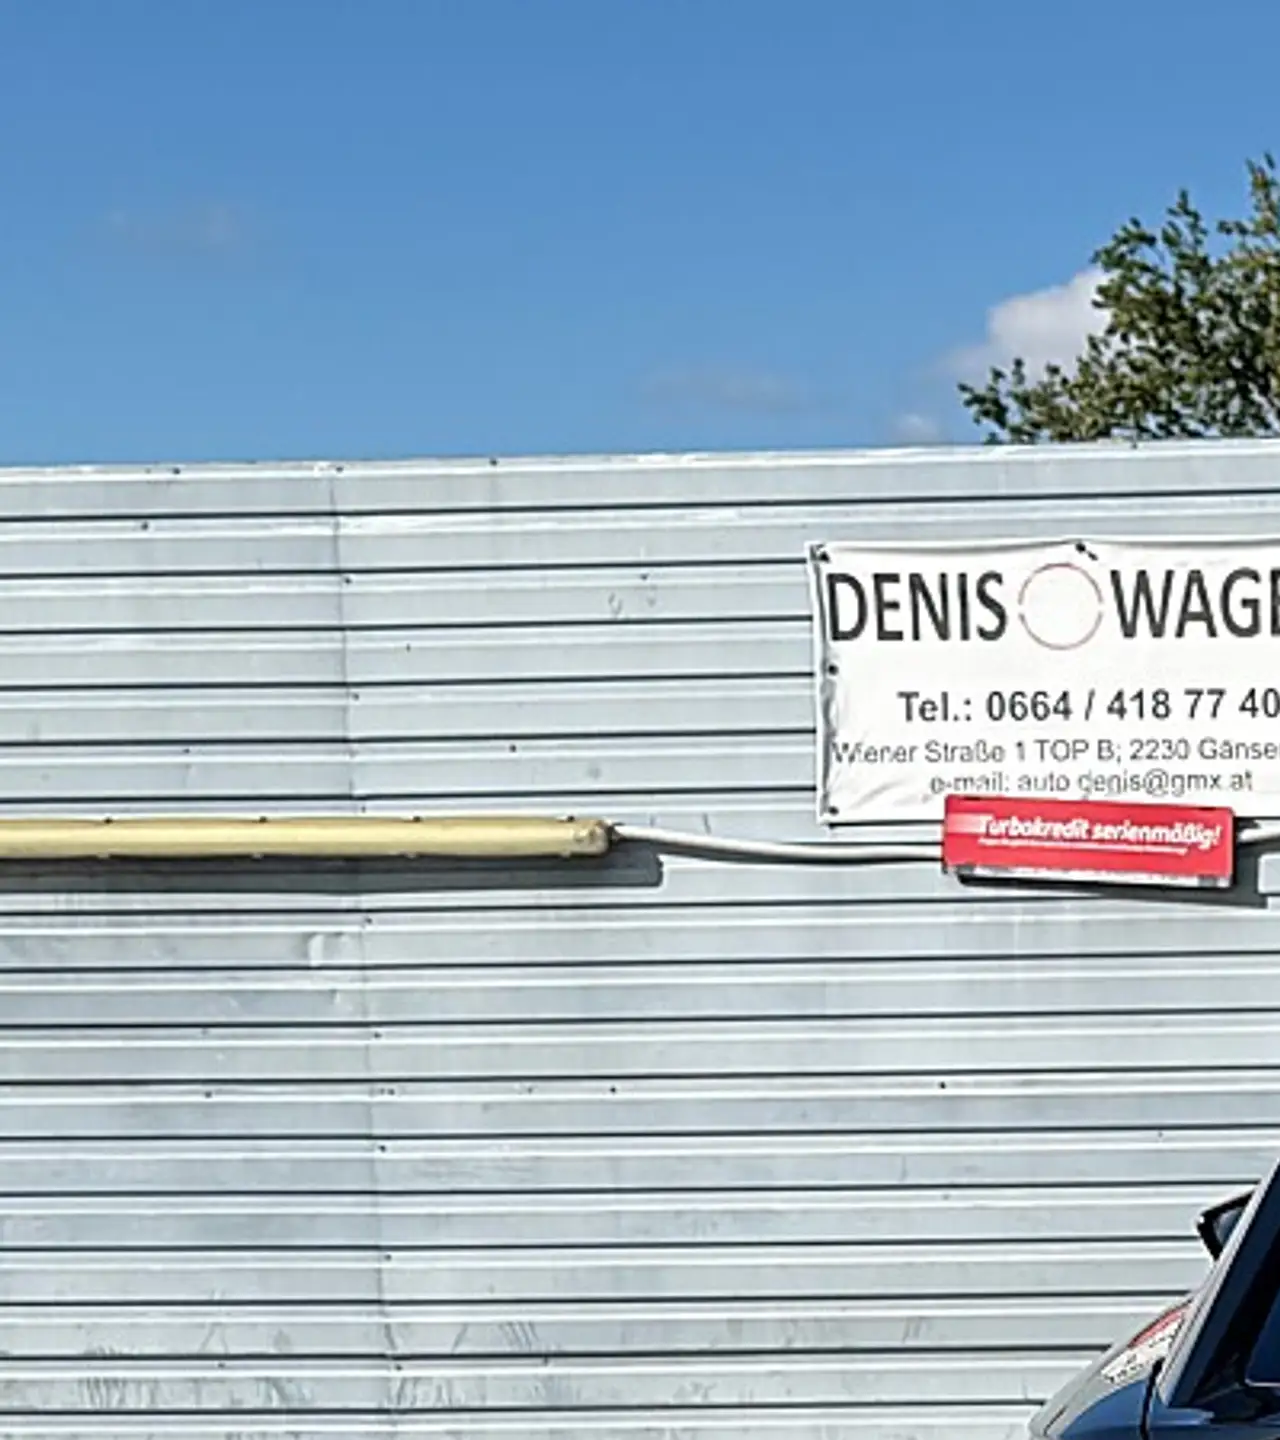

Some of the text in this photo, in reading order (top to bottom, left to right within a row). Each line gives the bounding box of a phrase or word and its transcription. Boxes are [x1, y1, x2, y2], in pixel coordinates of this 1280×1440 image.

[827, 570, 1009, 641] DENIS
[897, 691, 972, 722] Tel.:
[986, 690, 1073, 721] 0664
[1084, 688, 1096, 721] /
[1107, 688, 1171, 720] 418
[1184, 688, 1226, 719] 77
[832, 742, 917, 764] Wiener
[924, 739, 1006, 763] Straße
[1015, 740, 1027, 761] 1
[1033, 739, 1090, 761] TOP
[1129, 737, 1190, 761] 2230
[978, 814, 1090, 841] Turbokredit
